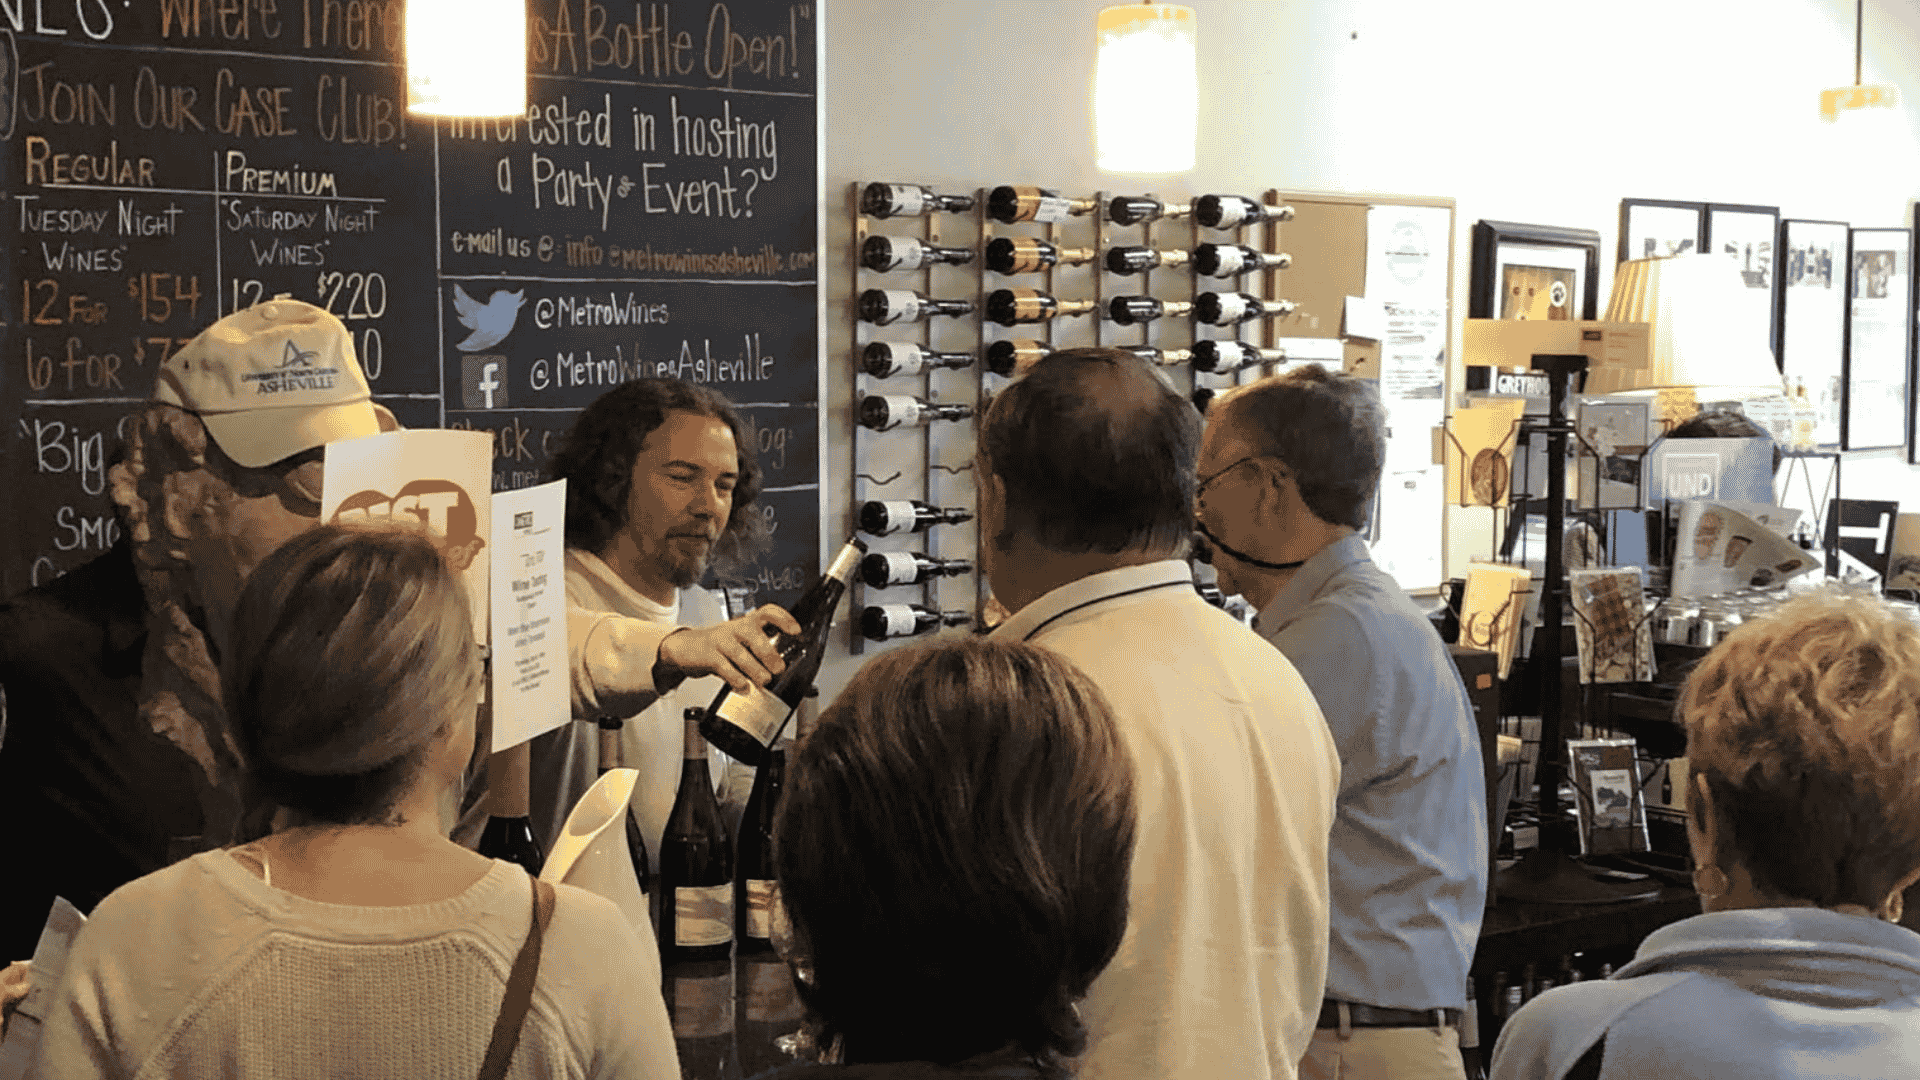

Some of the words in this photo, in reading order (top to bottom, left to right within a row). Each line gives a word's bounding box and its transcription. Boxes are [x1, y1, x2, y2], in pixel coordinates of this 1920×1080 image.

[584, 0, 696, 77] Bottle
[632, 106, 655, 151] in
[671, 95, 778, 181] hosting
[497, 156, 512, 195] a
[532, 152, 613, 232] Party
[643, 162, 760, 219] Event?
[506, 237, 531, 257] us
[23, 279, 63, 325] 12
[128, 272, 201, 323] $154
[534, 291, 670, 330] @MetroWines
[257, 376, 335, 395] ASHEVILLE
